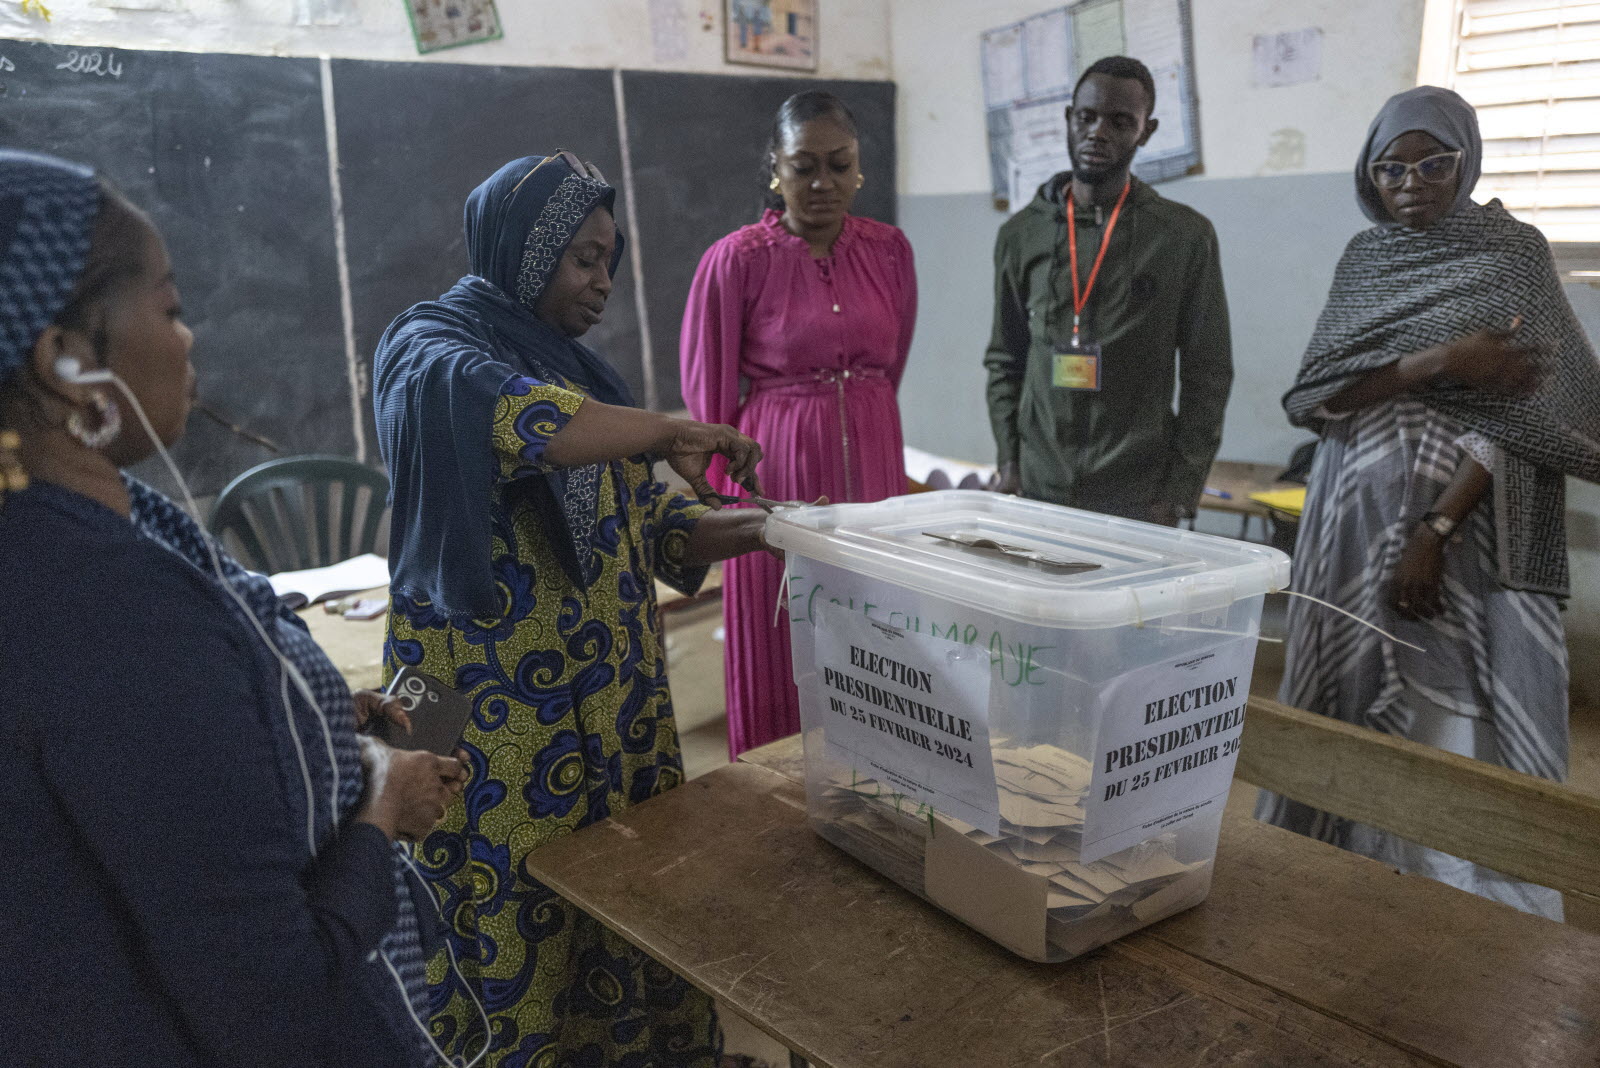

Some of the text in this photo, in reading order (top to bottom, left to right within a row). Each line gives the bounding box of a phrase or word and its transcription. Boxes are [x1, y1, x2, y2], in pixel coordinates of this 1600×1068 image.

[56, 50, 123, 79] 2024
[850, 645, 932, 694] ELECTION
[824, 667, 972, 742] PRESIDENTIELLE
[1144, 676, 1238, 725] ELECTION
[830, 697, 974, 768] DU 25 FEVRIER 2024
[1104, 779, 1128, 802] DU
[1131, 771, 1150, 792] 25
[1154, 746, 1218, 783] FEVRIER
